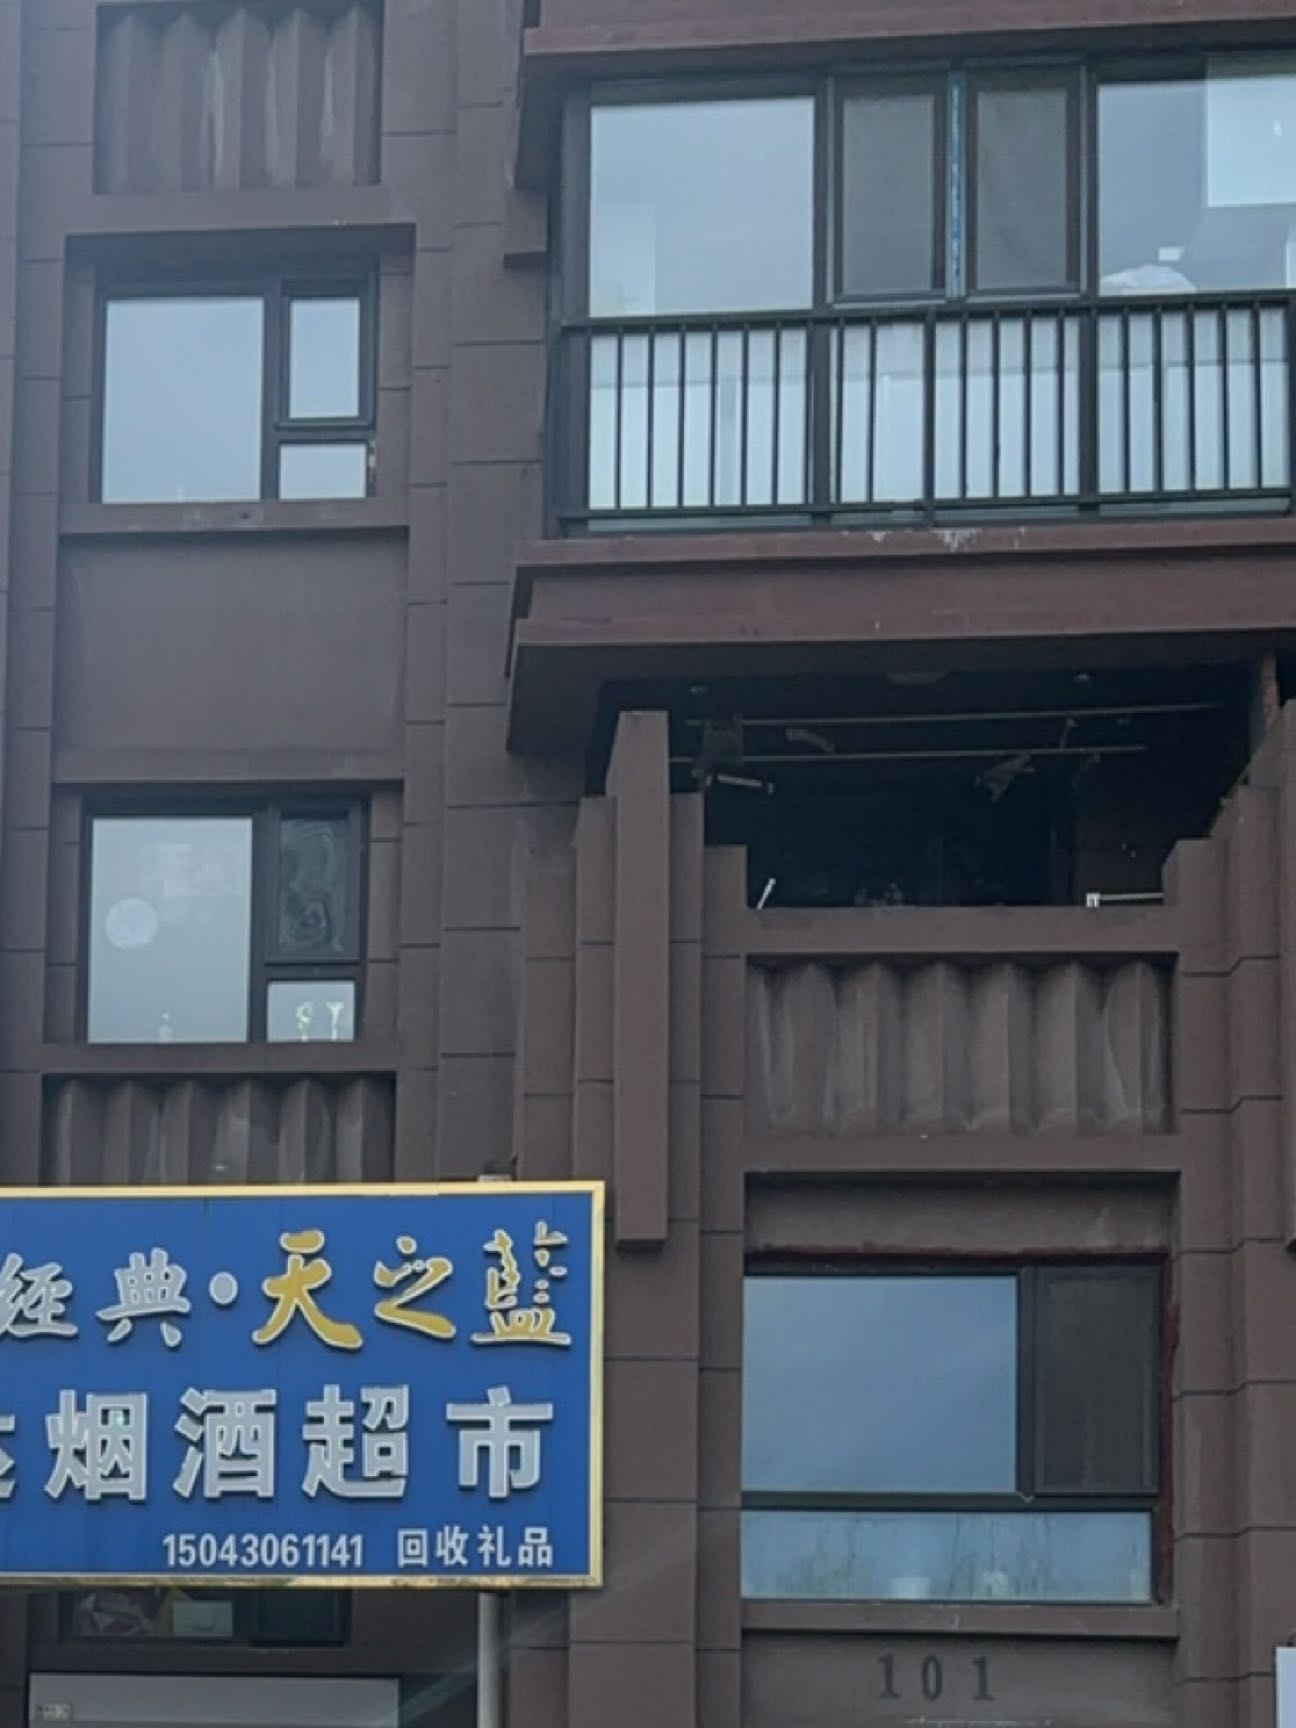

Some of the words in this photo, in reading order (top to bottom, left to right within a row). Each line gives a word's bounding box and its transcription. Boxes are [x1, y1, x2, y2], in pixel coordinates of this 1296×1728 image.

[162, 1533, 365, 1570] 15043061141
[396, 1525, 554, 1569] 回收礼品
[877, 1653, 996, 1700] 101
